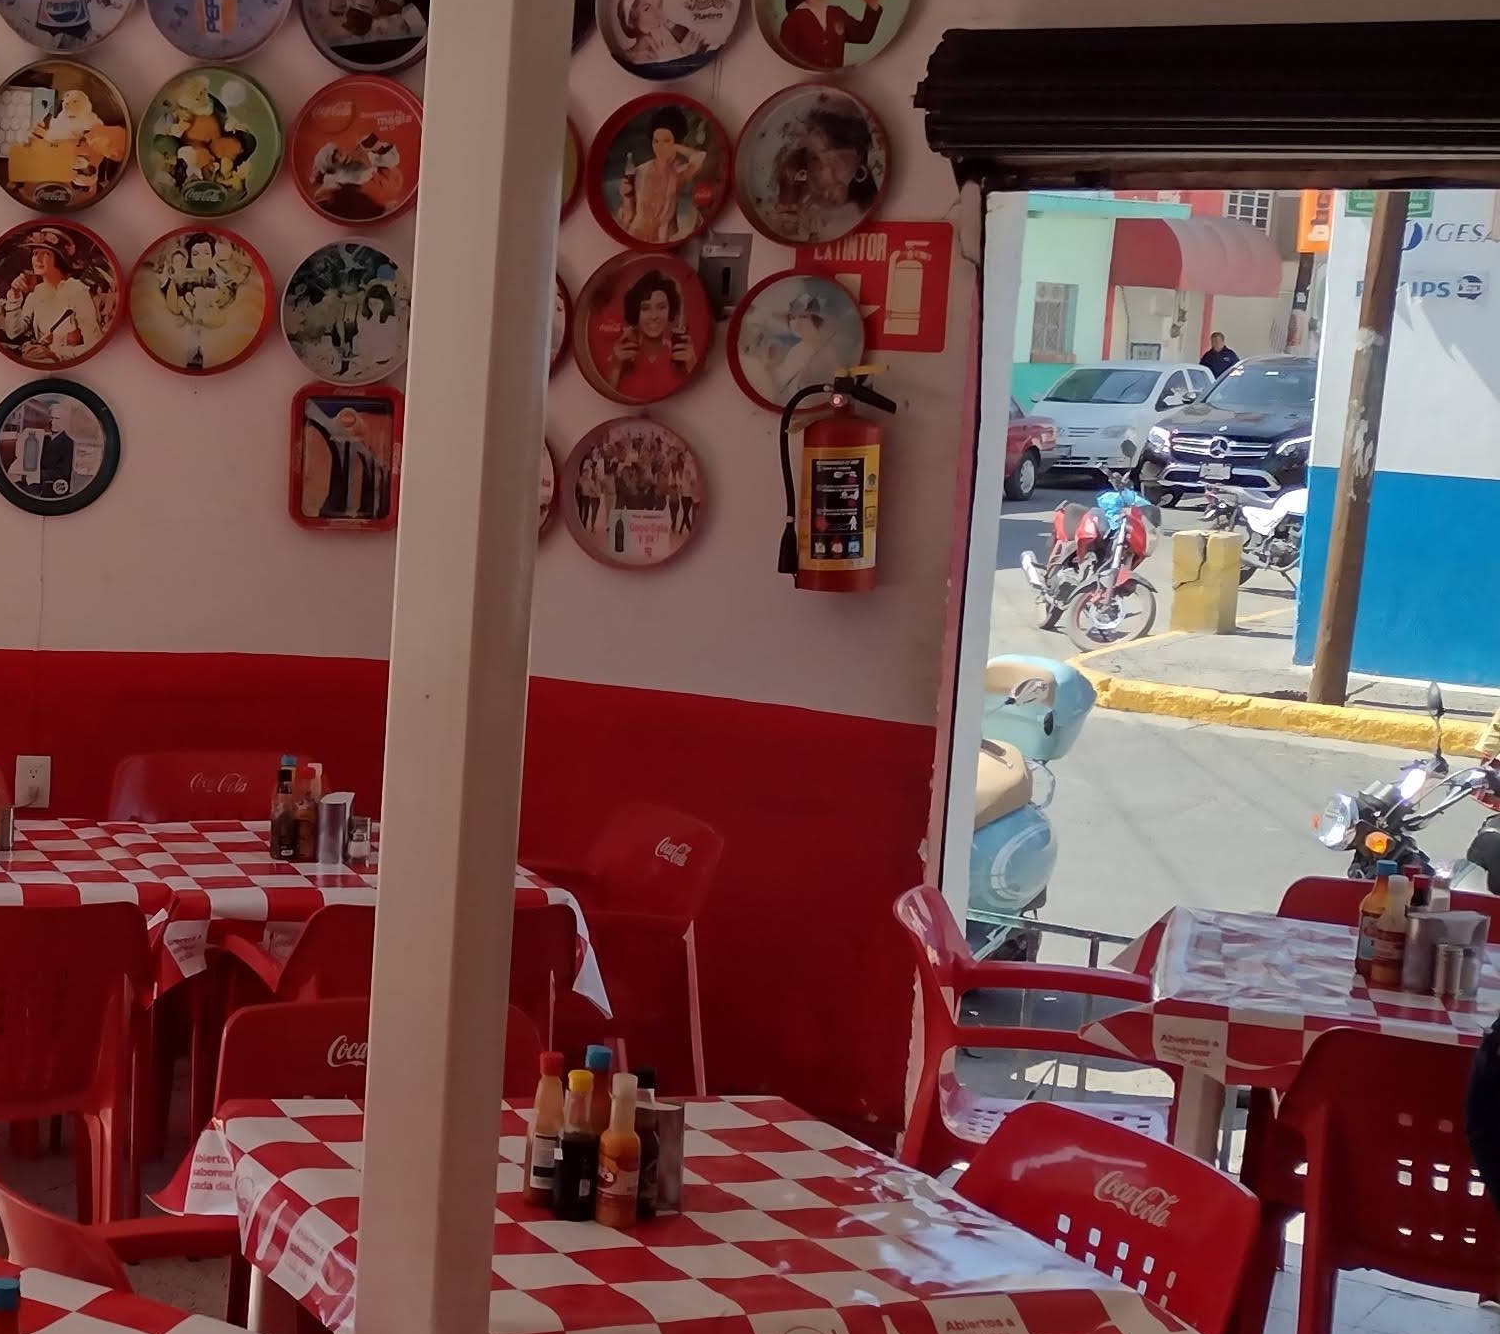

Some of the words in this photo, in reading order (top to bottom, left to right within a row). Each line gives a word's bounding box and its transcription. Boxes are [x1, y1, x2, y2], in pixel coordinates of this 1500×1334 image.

[46, 1, 80, 12] PEPSI
[189, 772, 249, 794] Coca-Cola
[1094, 1171, 1180, 1228] Coca-Cola
[945, 1318, 1000, 1334] Abiertos
[1005, 1317, 1016, 1327] a
